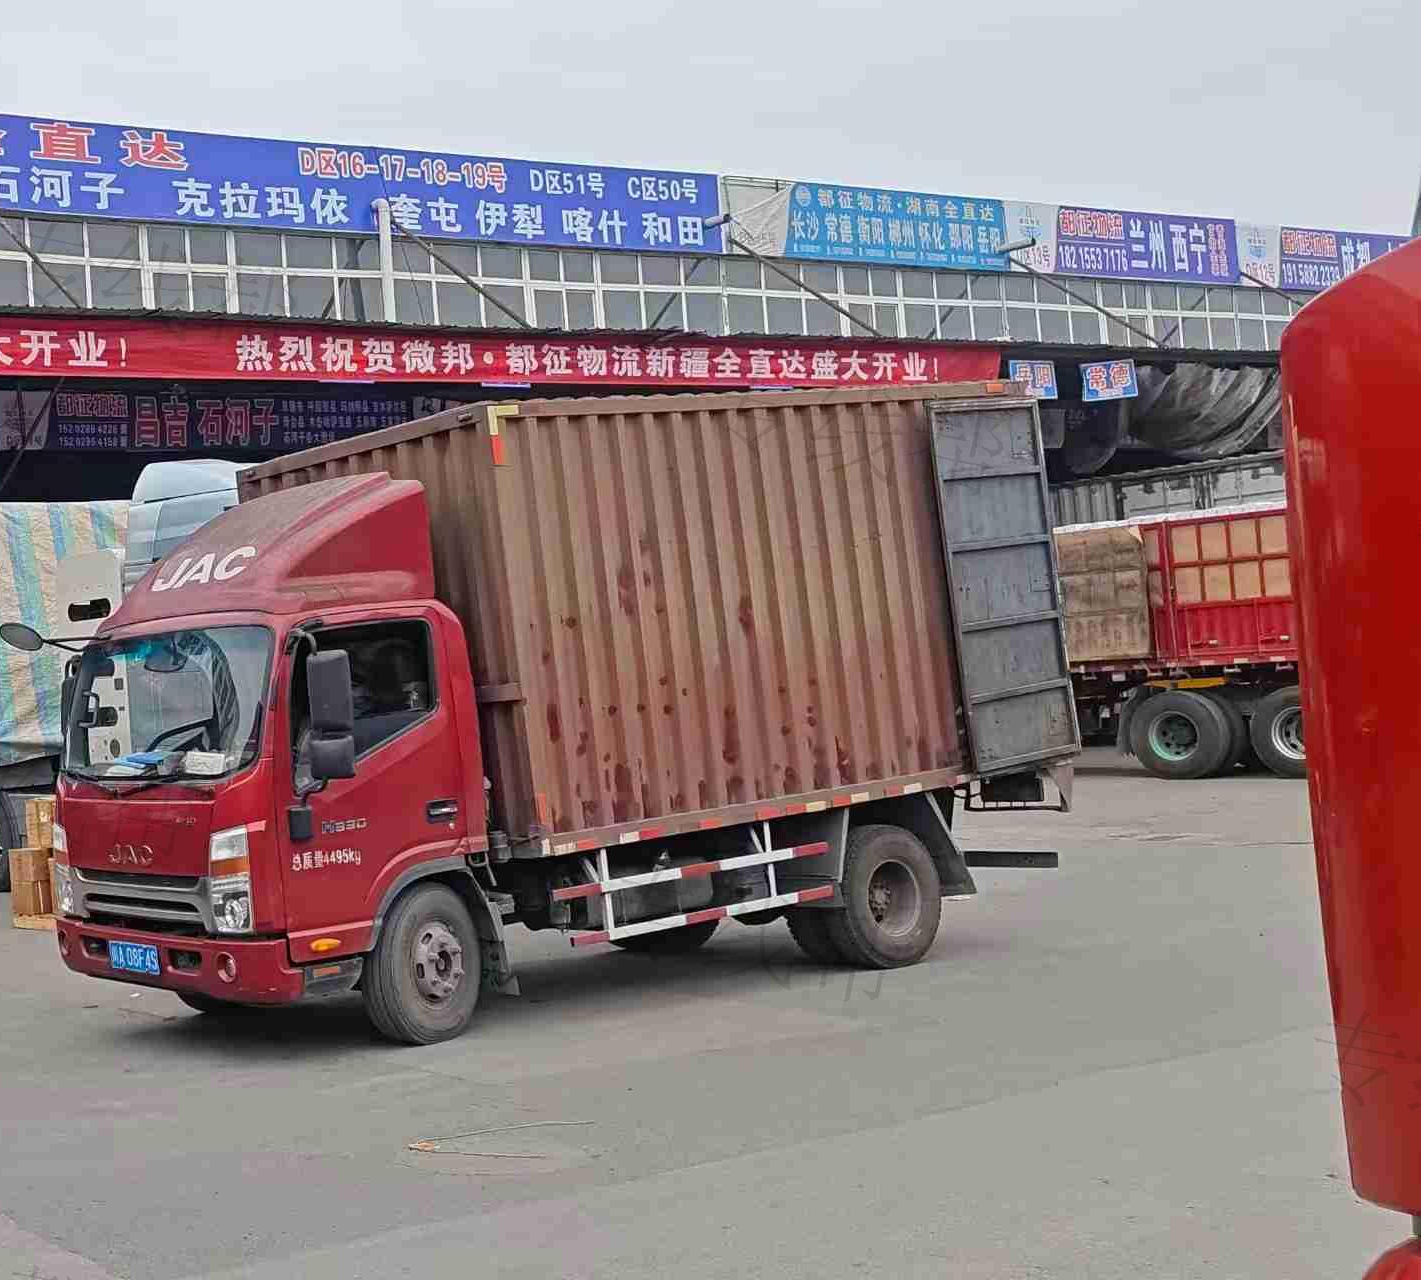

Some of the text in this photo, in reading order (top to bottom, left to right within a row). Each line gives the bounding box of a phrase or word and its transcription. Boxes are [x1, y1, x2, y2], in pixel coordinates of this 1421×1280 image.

[297, 147, 699, 204] D区16-17-18-19号 D区51号 C区50号
[171, 177, 350, 225] 克拉玛依
[389, 193, 462, 232] 奎屯
[475, 199, 546, 238] 伊犁
[561, 206, 627, 244] 喀什
[641, 211, 705, 246] 和田
[817, 188, 995, 222] 都征物流·湖南全直达
[791, 210, 819, 241] 长沙
[824, 212, 853, 243] 常德
[918, 221, 945, 250] 怀化
[1129, 216, 1167, 273] 兰州
[1170, 222, 1207, 275] 西宁
[1058, 244, 1077, 269] 182
[1086, 362, 1131, 391] 常德
[133, 395, 280, 448] 昌吉 石河子
[152, 546, 256, 592] JAC
